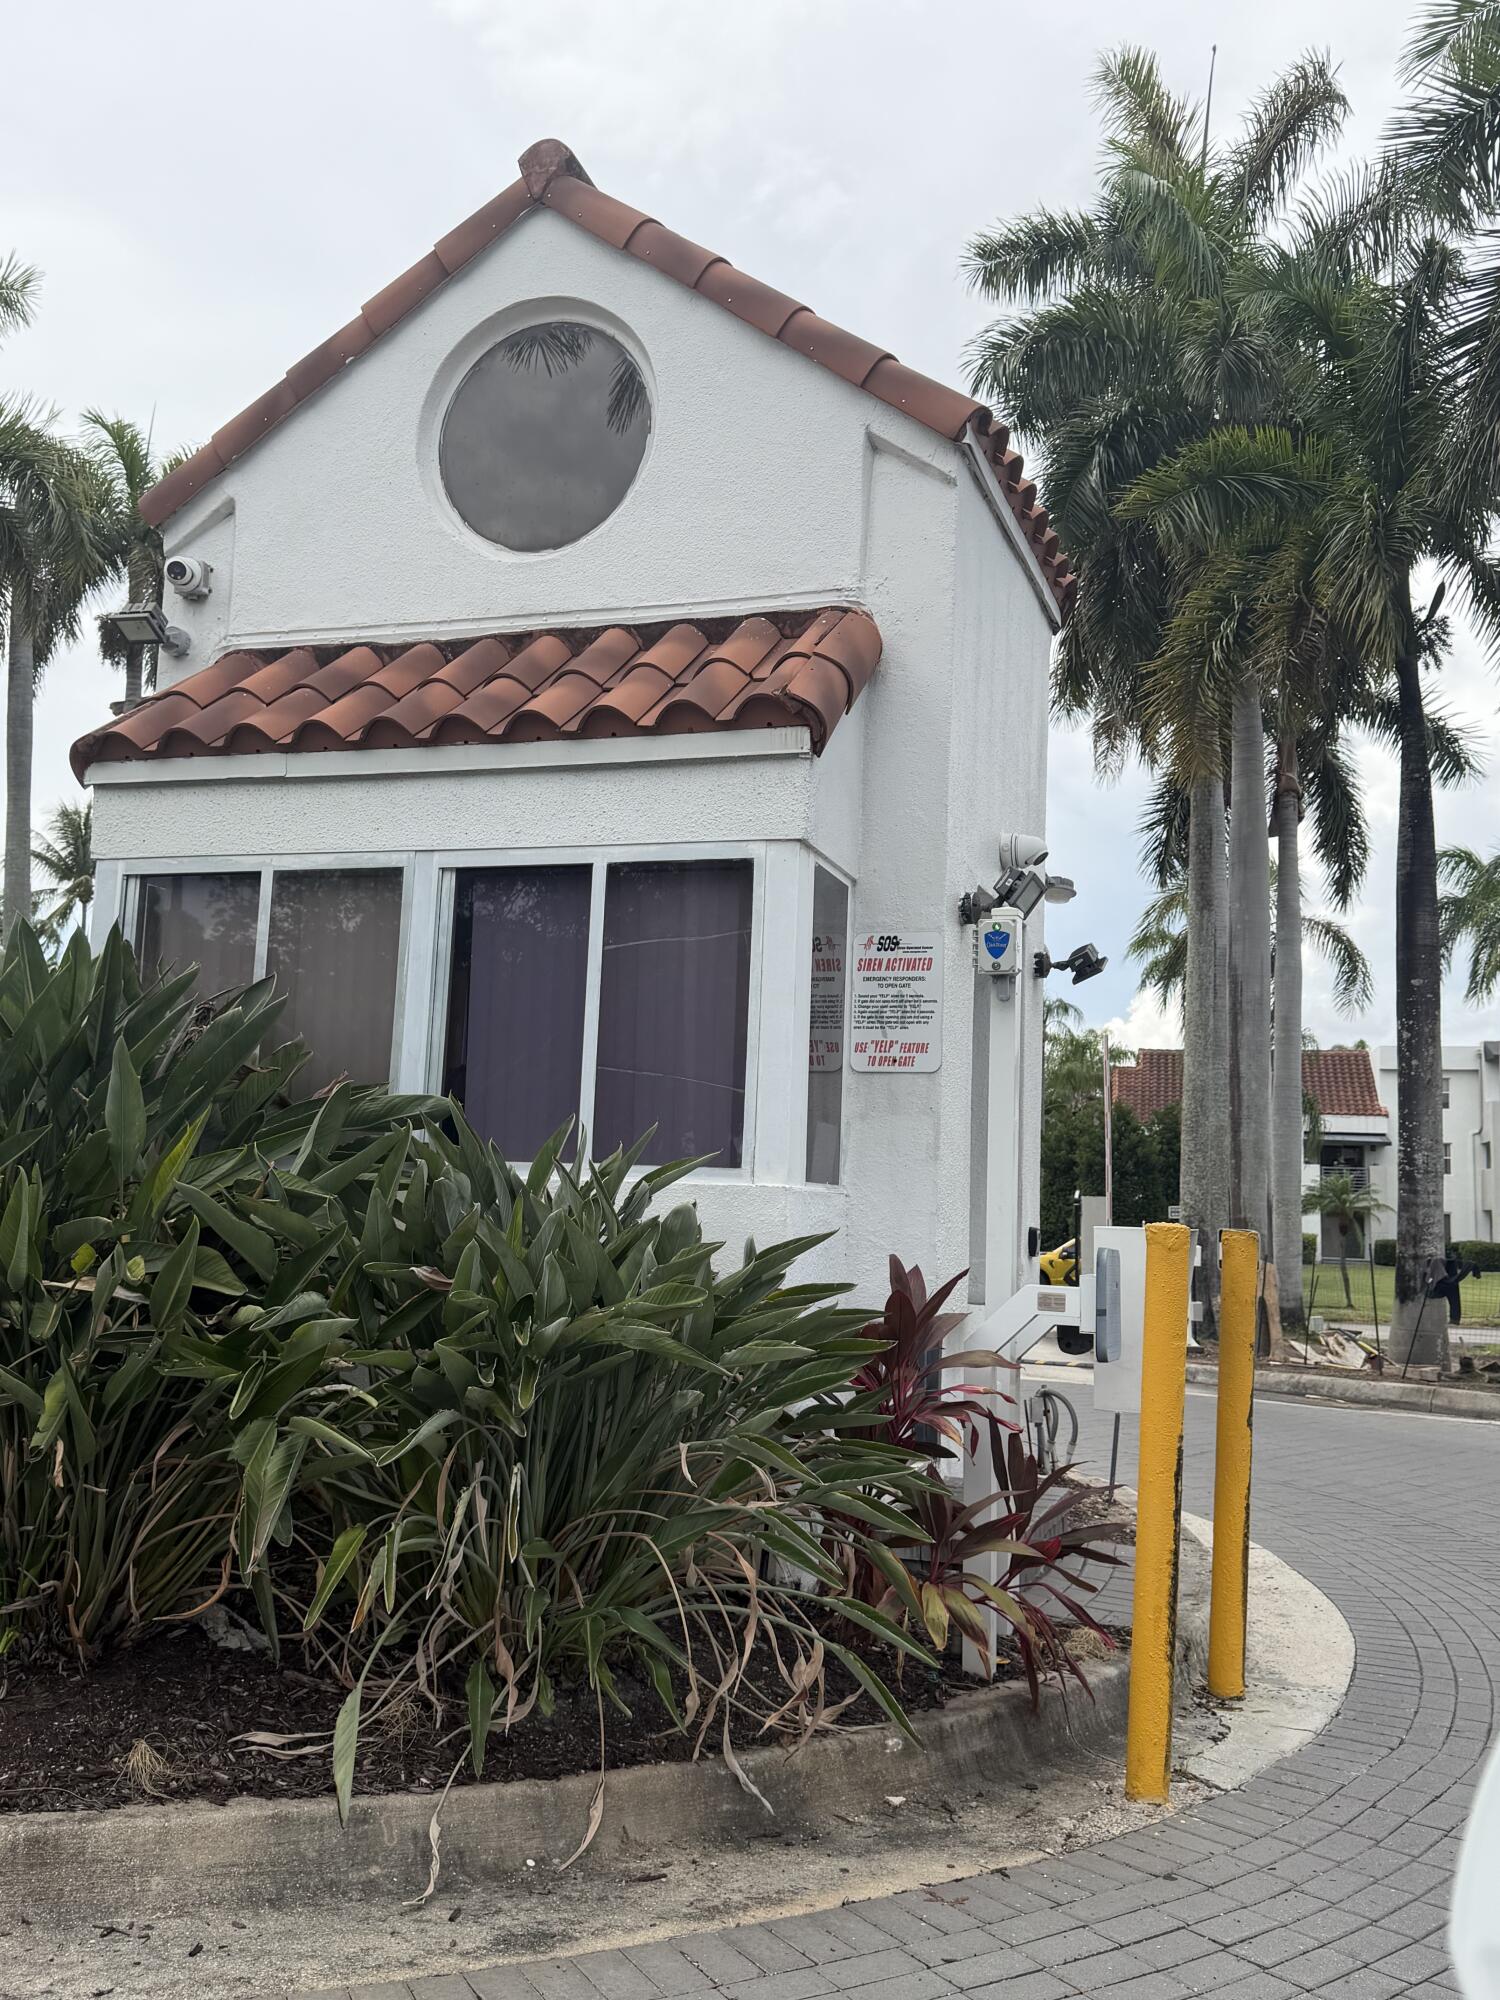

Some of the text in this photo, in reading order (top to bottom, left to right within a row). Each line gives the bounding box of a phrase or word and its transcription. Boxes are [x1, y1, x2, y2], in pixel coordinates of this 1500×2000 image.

[857, 957, 933, 972] SIREN ACTIVATED
[854, 1039, 930, 1054] USE "YELP" FEATURE
[867, 1056, 916, 1067] TO OPEN GATE
